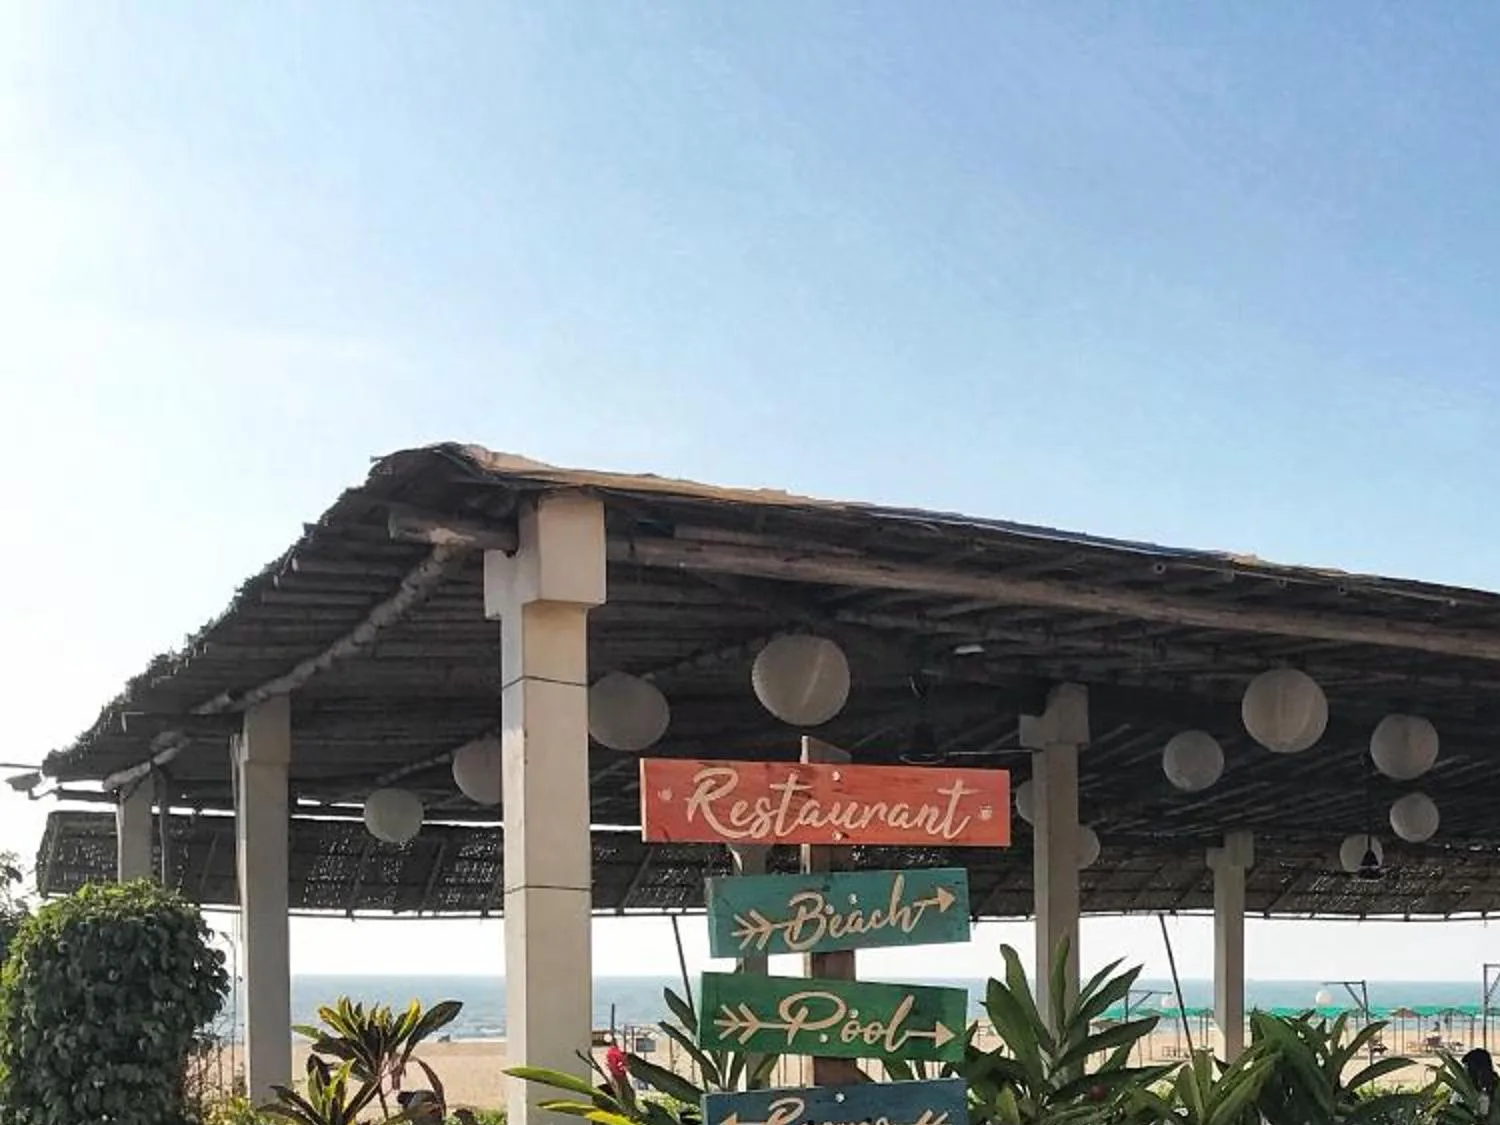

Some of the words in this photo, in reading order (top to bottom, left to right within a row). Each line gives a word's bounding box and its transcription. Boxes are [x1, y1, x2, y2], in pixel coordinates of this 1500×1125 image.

[685, 767, 975, 839] Restaurant
[783, 875, 922, 950] Beach
[778, 991, 910, 1053] Pool
